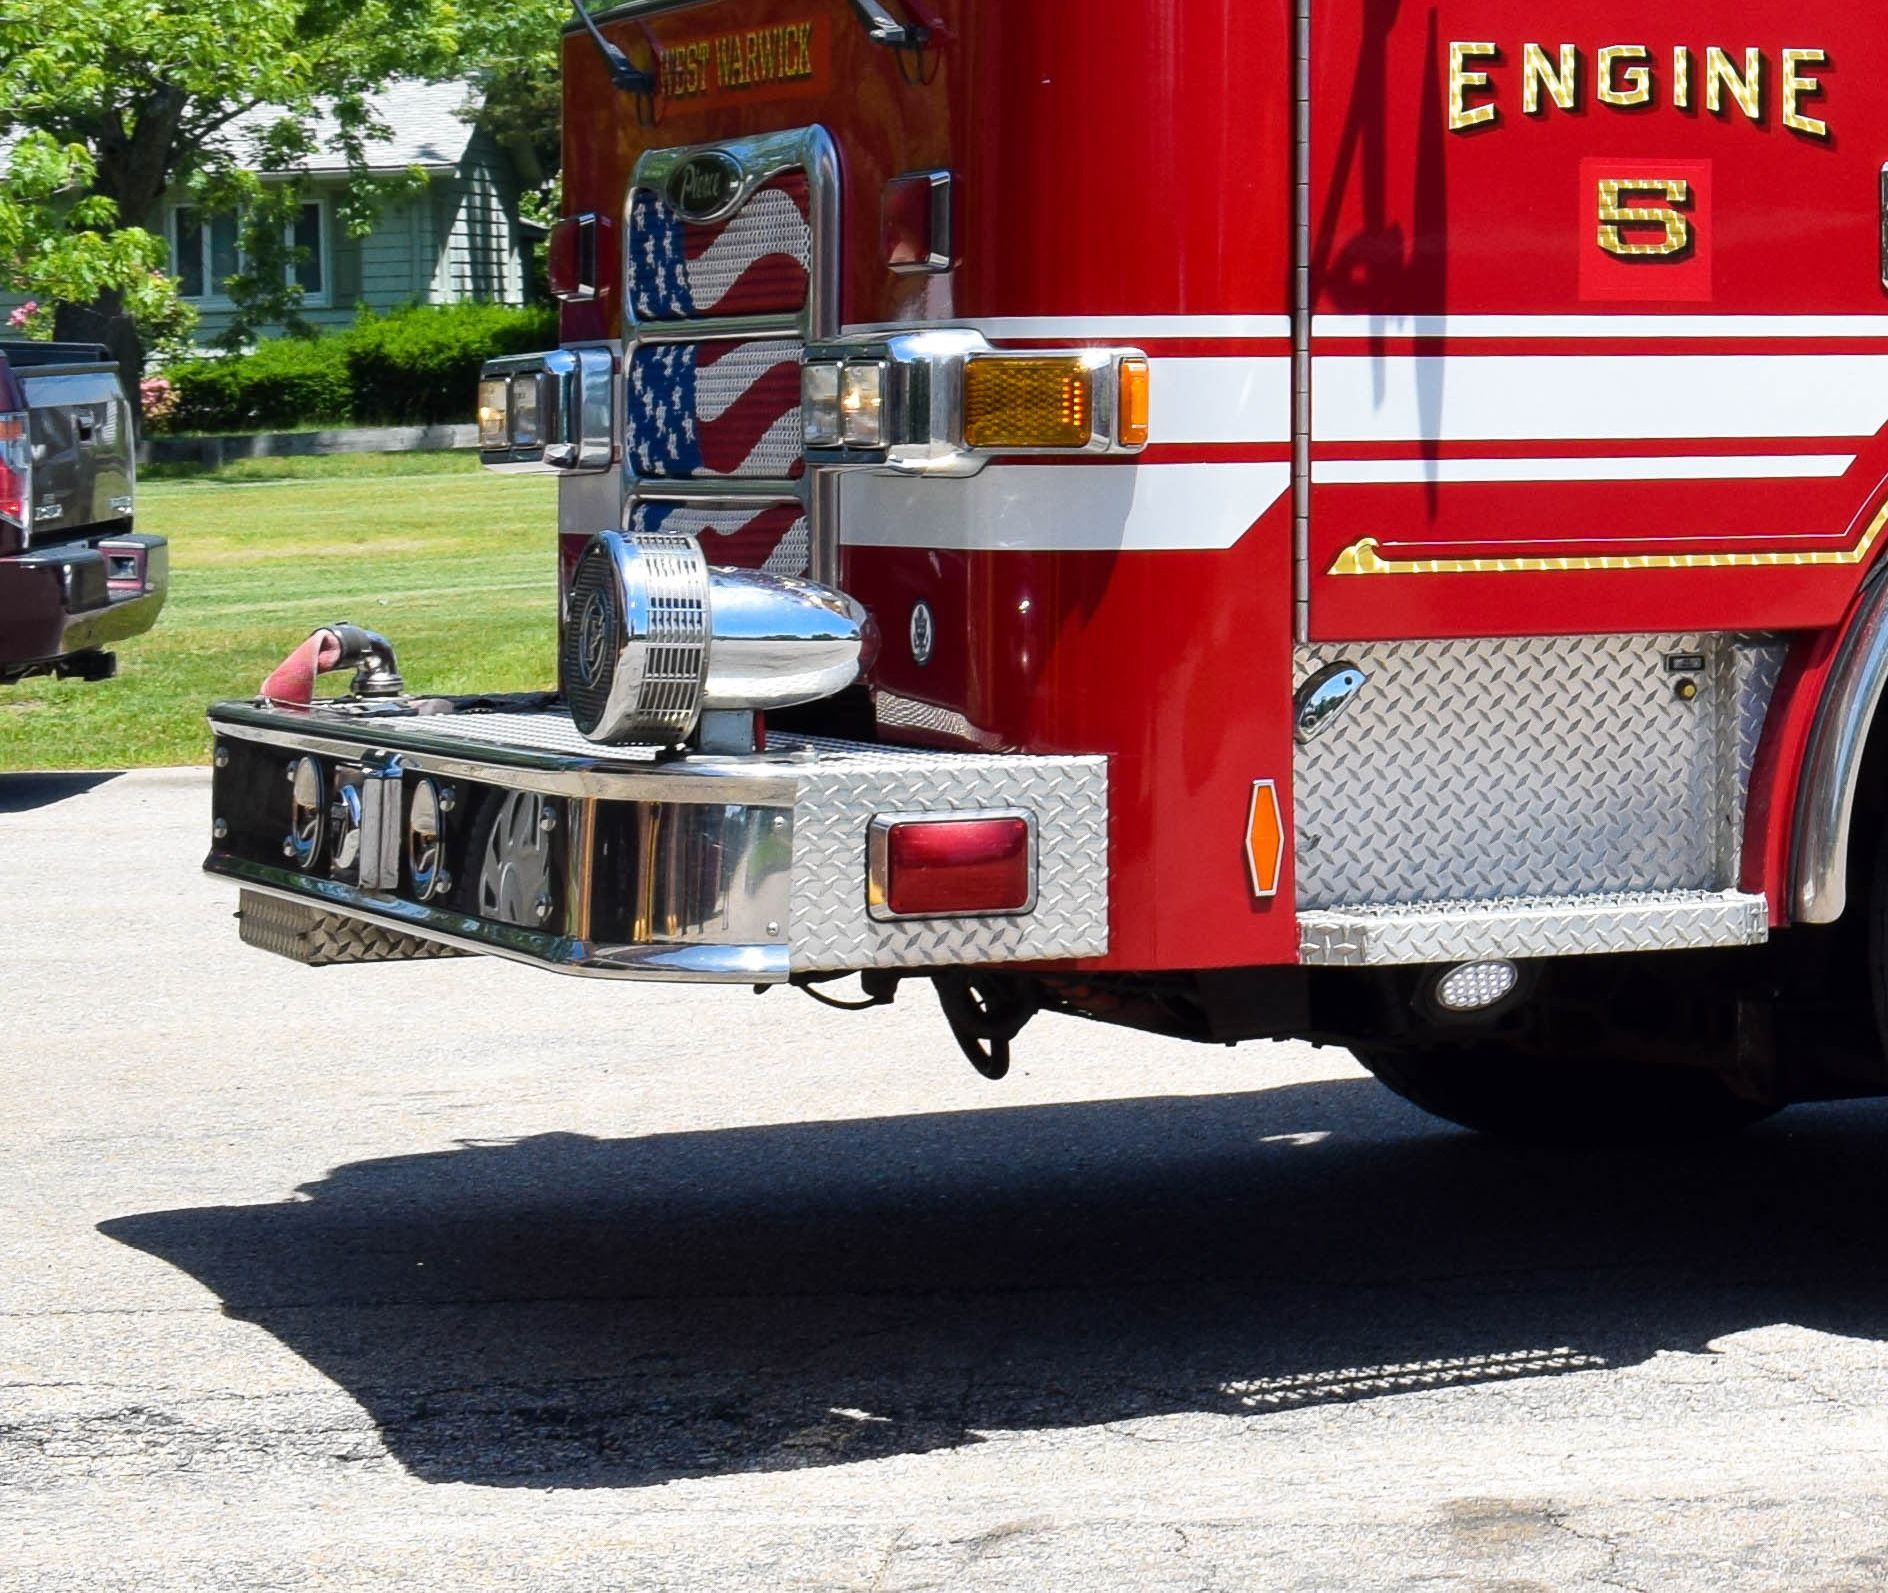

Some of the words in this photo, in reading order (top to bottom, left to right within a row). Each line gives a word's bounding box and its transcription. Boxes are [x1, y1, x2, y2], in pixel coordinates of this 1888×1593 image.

[659, 41, 710, 97] WEST
[715, 23, 814, 88] WARWICK
[1448, 41, 1829, 137] ENGINE
[1596, 178, 1688, 257] 5
